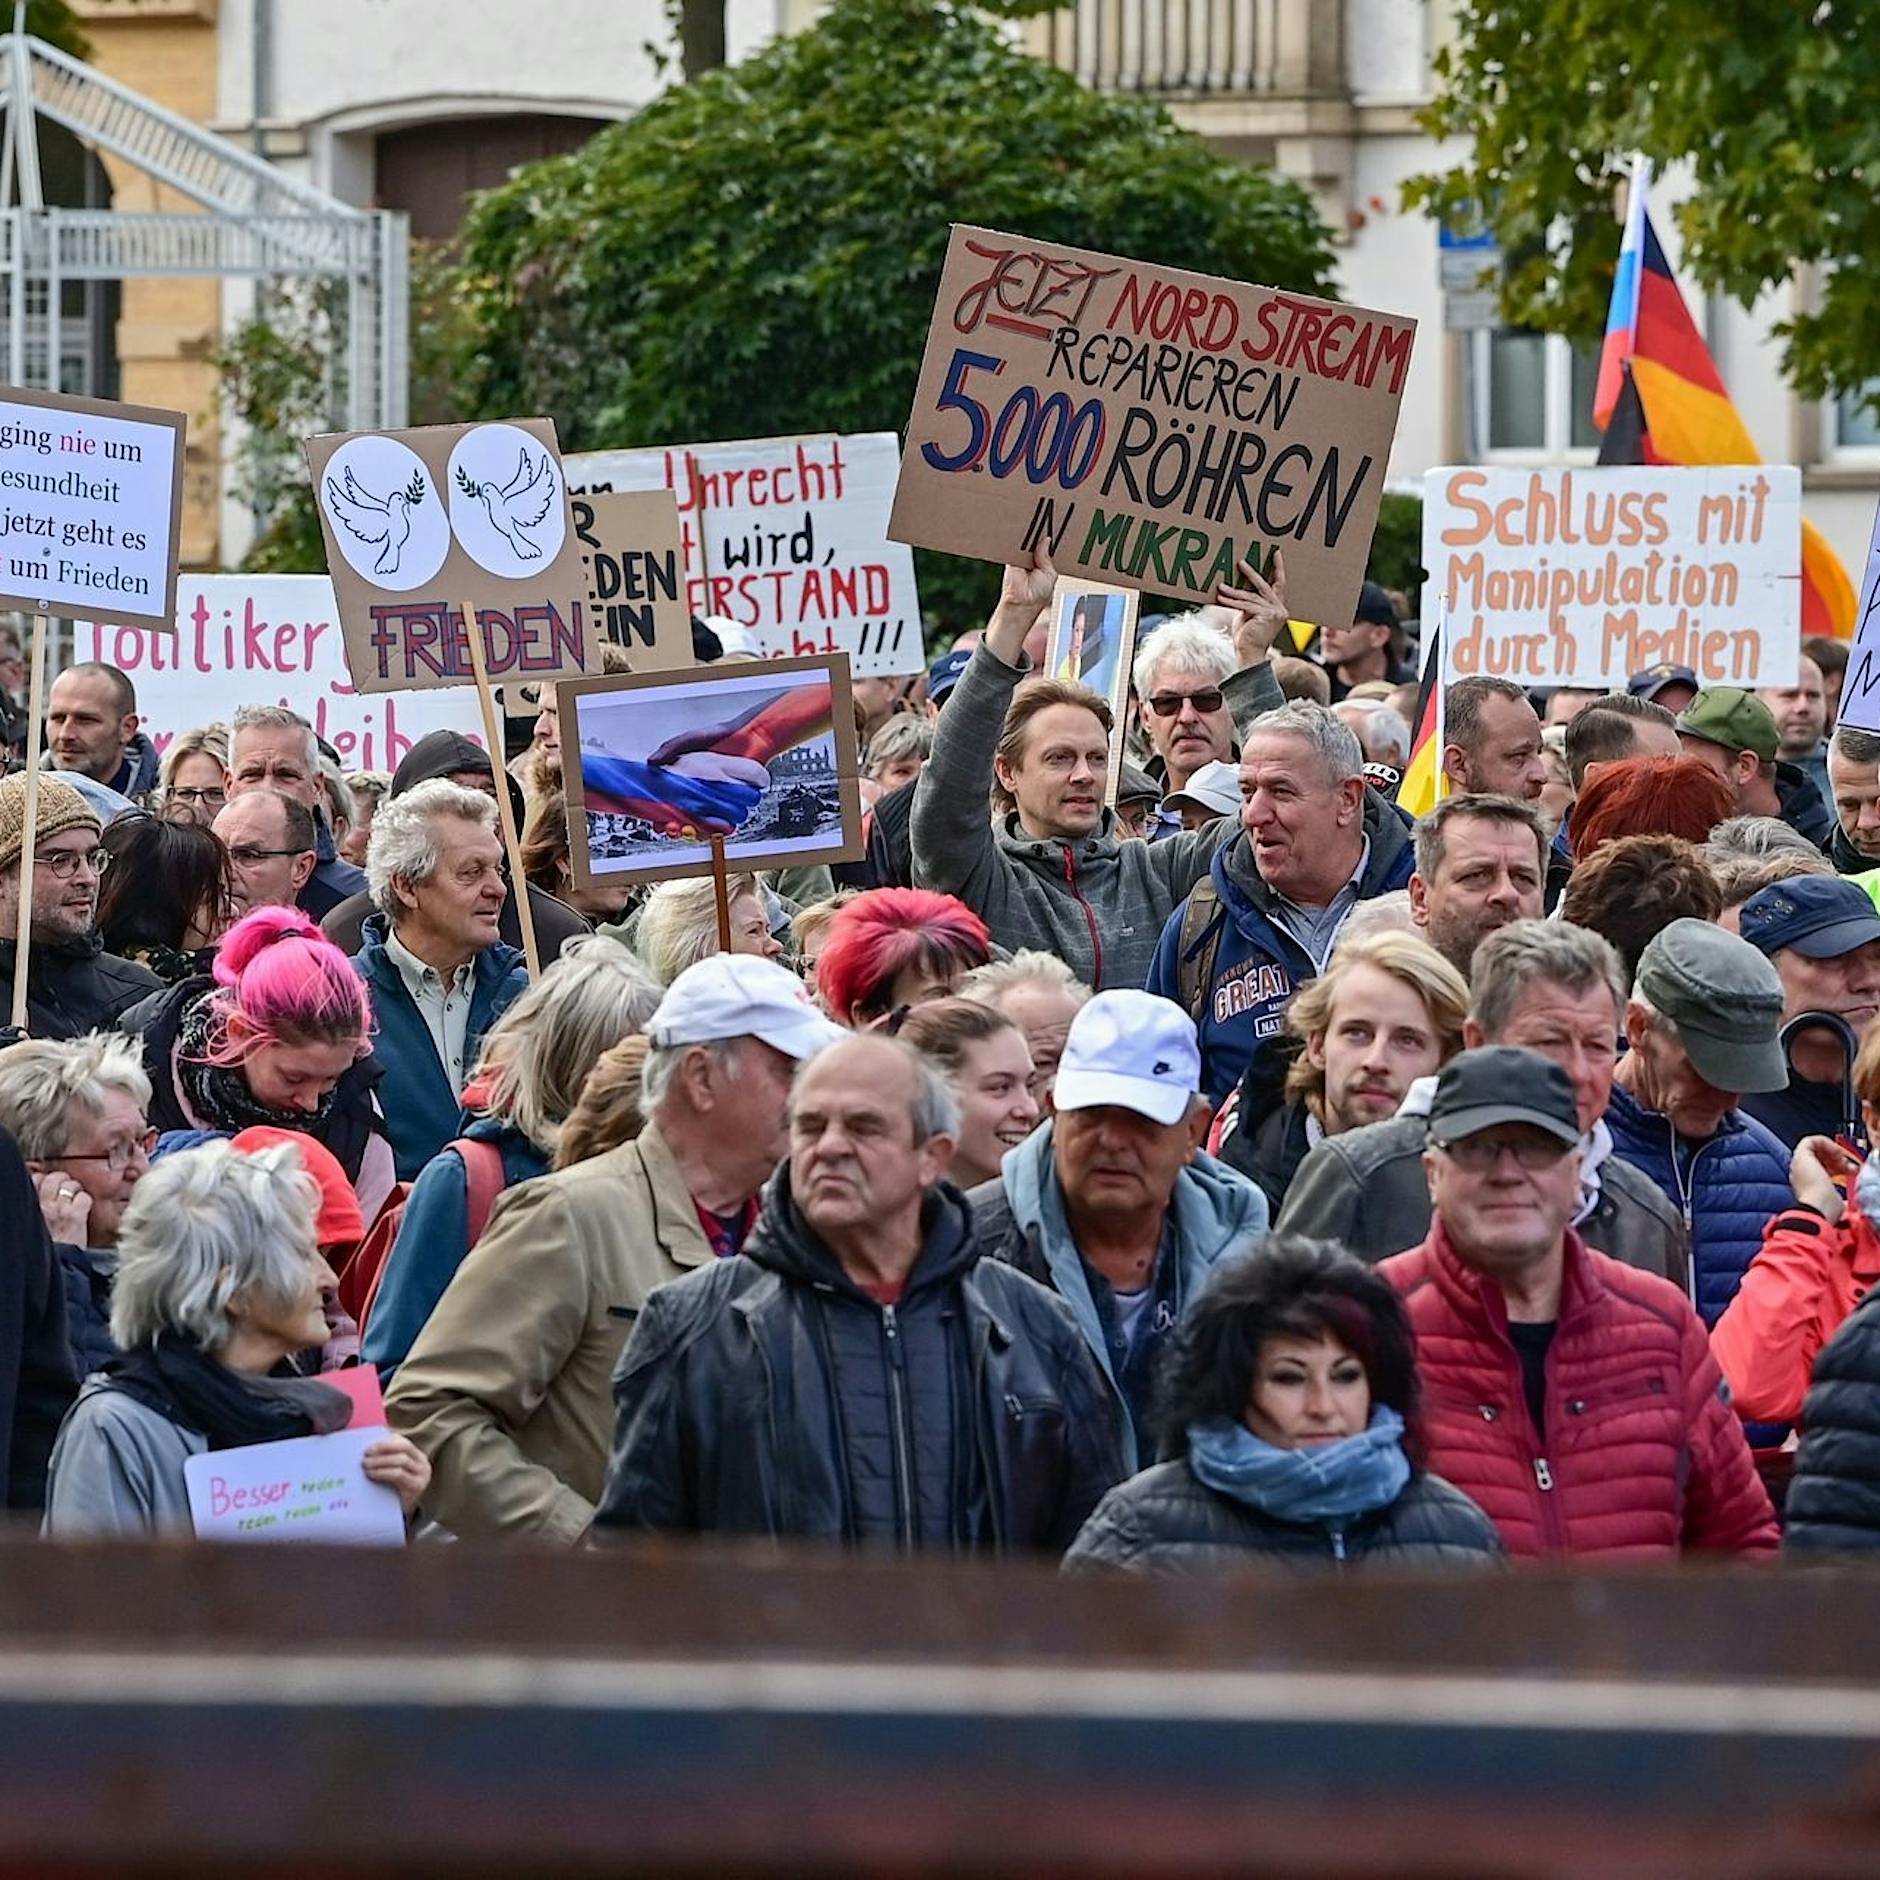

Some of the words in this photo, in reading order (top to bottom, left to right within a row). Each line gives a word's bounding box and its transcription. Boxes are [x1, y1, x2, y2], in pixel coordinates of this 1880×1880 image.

[953, 240, 1123, 333] JETZT
[1106, 273, 1239, 352] NORD
[1241, 295, 1413, 394] STREAM
[1046, 327, 1300, 431] REPARIEREN
[0, 420, 52, 455] ging
[59, 430, 97, 456] nie
[103, 439, 143, 463] um
[921, 348, 1106, 490] 5.000
[1100, 407, 1372, 549] RÖHREN
[0, 470, 121, 503] esundheit
[665, 441, 847, 513] Unrecht
[1440, 470, 1669, 546] Schluss
[1698, 472, 1772, 545] mit
[0, 507, 56, 538] jetzt
[62, 519, 115, 546] geht
[121, 530, 147, 551] es
[723, 511, 835, 570] wird,
[1020, 496, 1076, 557] IN
[1077, 508, 1280, 593] MUKRAN
[10, 558, 48, 580] um
[56, 559, 150, 595] Frieden
[582, 550, 678, 600] DEN
[687, 562, 890, 627] ERSTAND
[1446, 549, 1740, 633] Manipulation
[369, 599, 585, 679] FRIEDEN
[1452, 614, 1577, 677] durch
[1600, 607, 1761, 681] Medien
[1260, 1018, 1280, 1034] NAT
[209, 1475, 292, 1518] Besser
